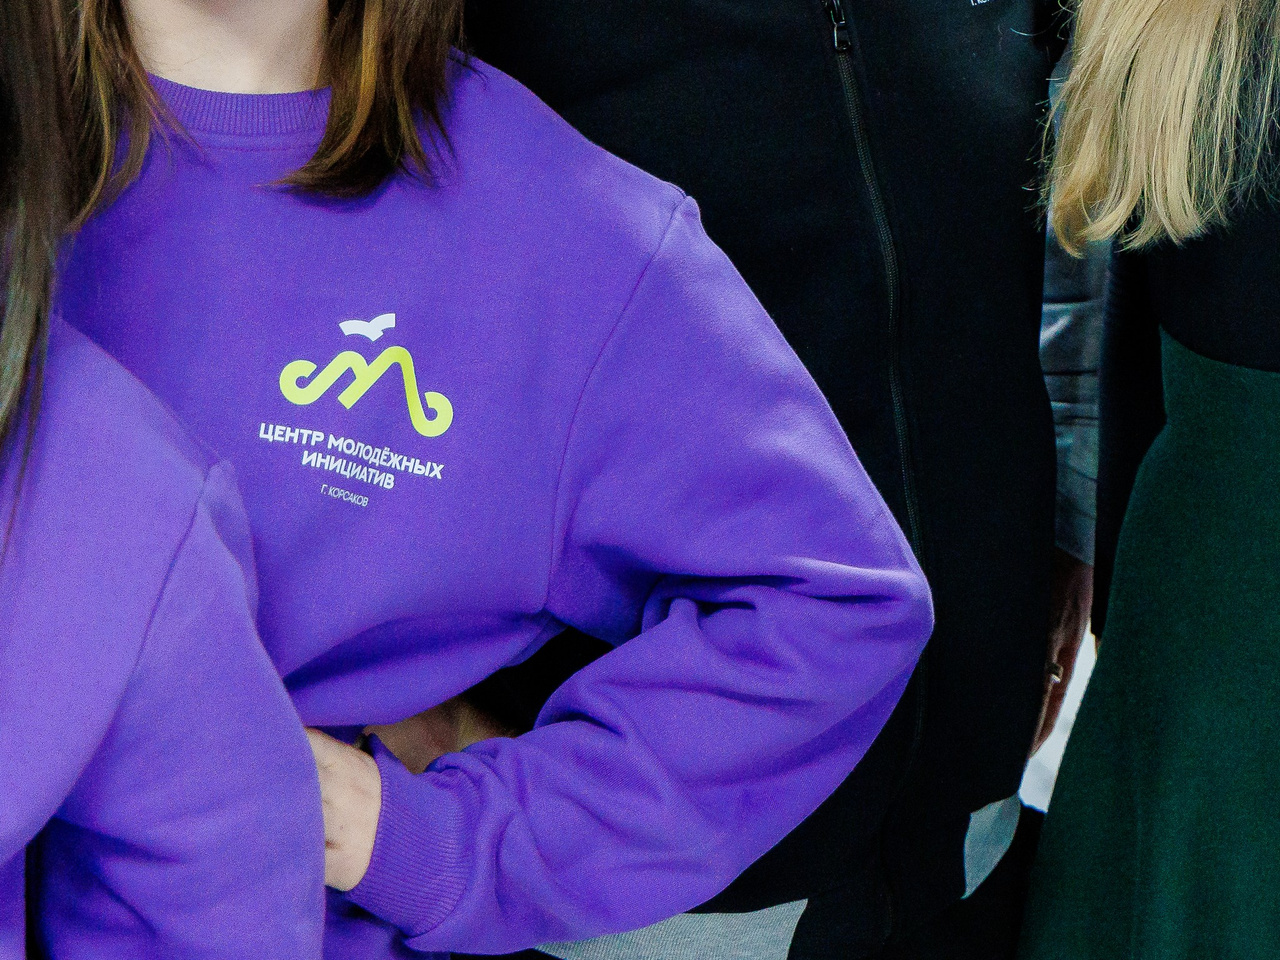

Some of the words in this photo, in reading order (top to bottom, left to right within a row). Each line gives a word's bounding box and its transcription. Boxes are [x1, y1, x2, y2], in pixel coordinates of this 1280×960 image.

[258, 422, 325, 446] ЦЕНТР
[327, 433, 445, 480] МОЛОДЁЖНЫХ
[301, 450, 395, 490] ИНИЦИАТИВ
[320, 483, 327, 495] Г.
[327, 486, 369, 507] КОРСАКОВ
